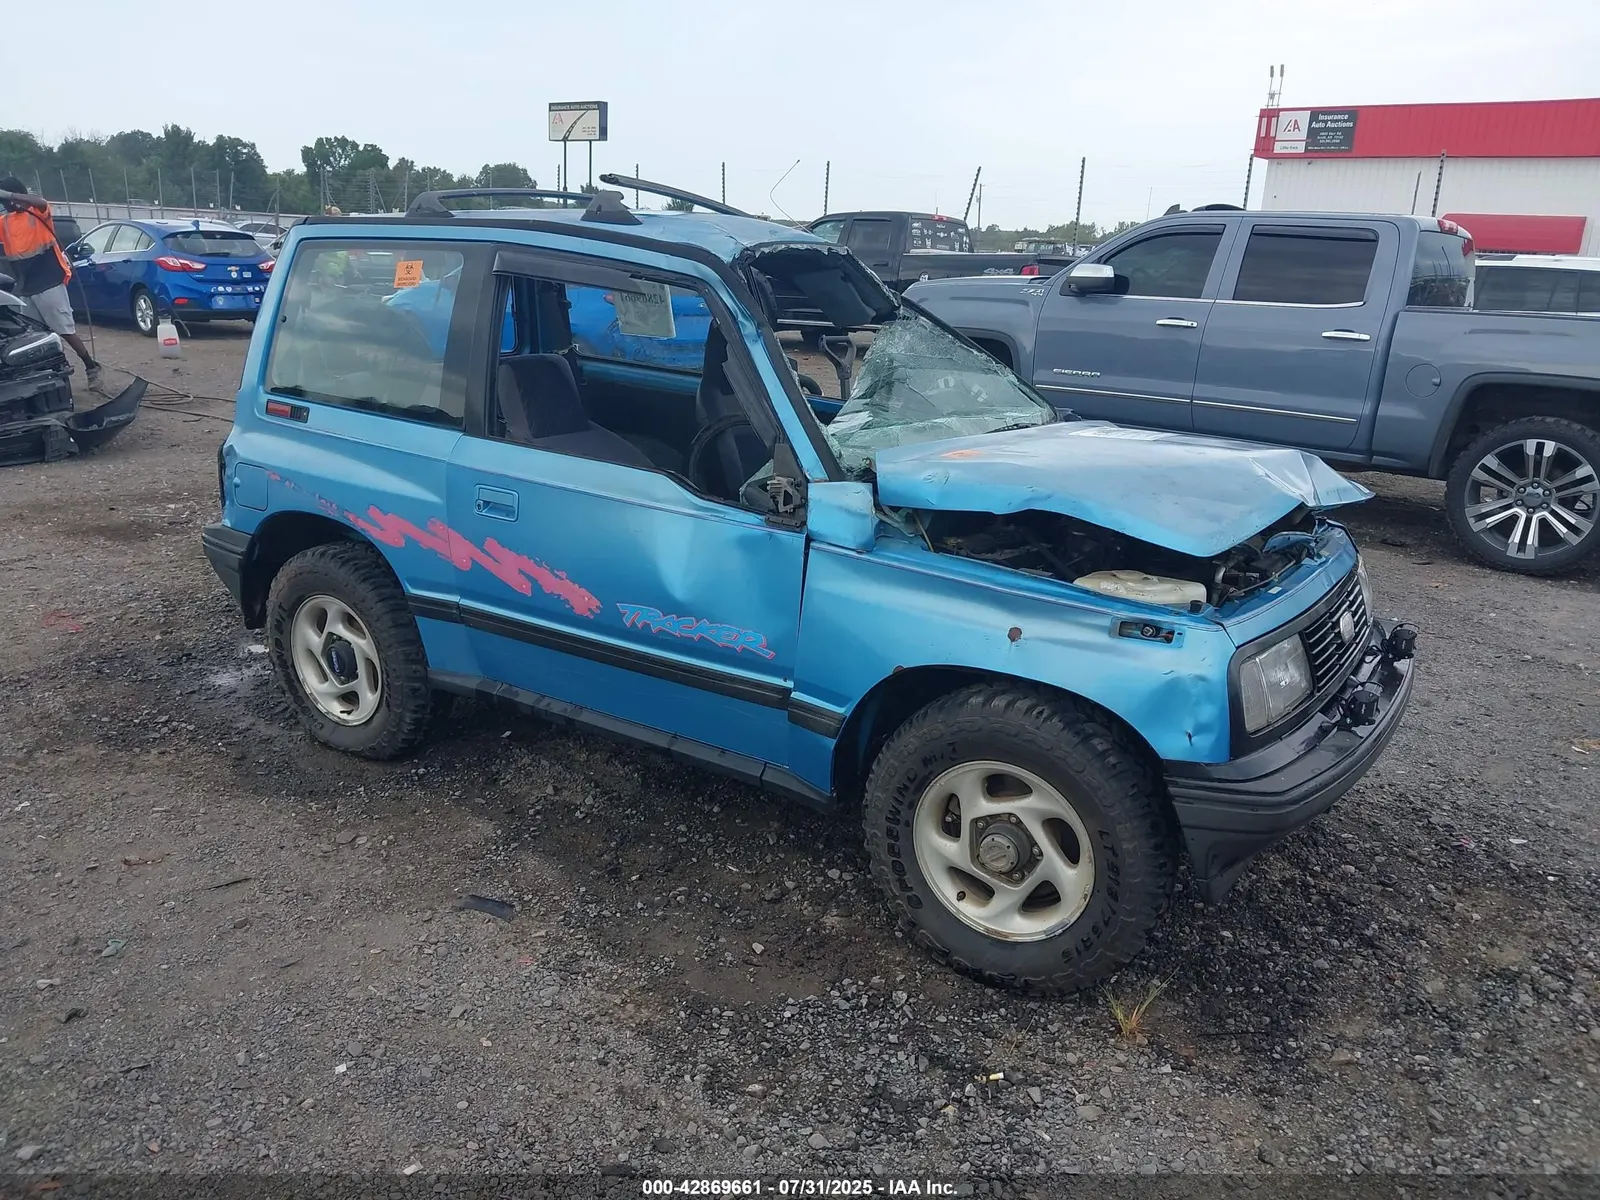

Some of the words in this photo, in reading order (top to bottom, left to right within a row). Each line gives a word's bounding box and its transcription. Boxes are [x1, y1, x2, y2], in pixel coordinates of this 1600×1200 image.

[1326, 120, 1354, 128] Auctions
[983, 268, 1015, 276] 4x4
[1053, 368, 1101, 378] SIERRA
[616, 603, 776, 660] TRACKER
